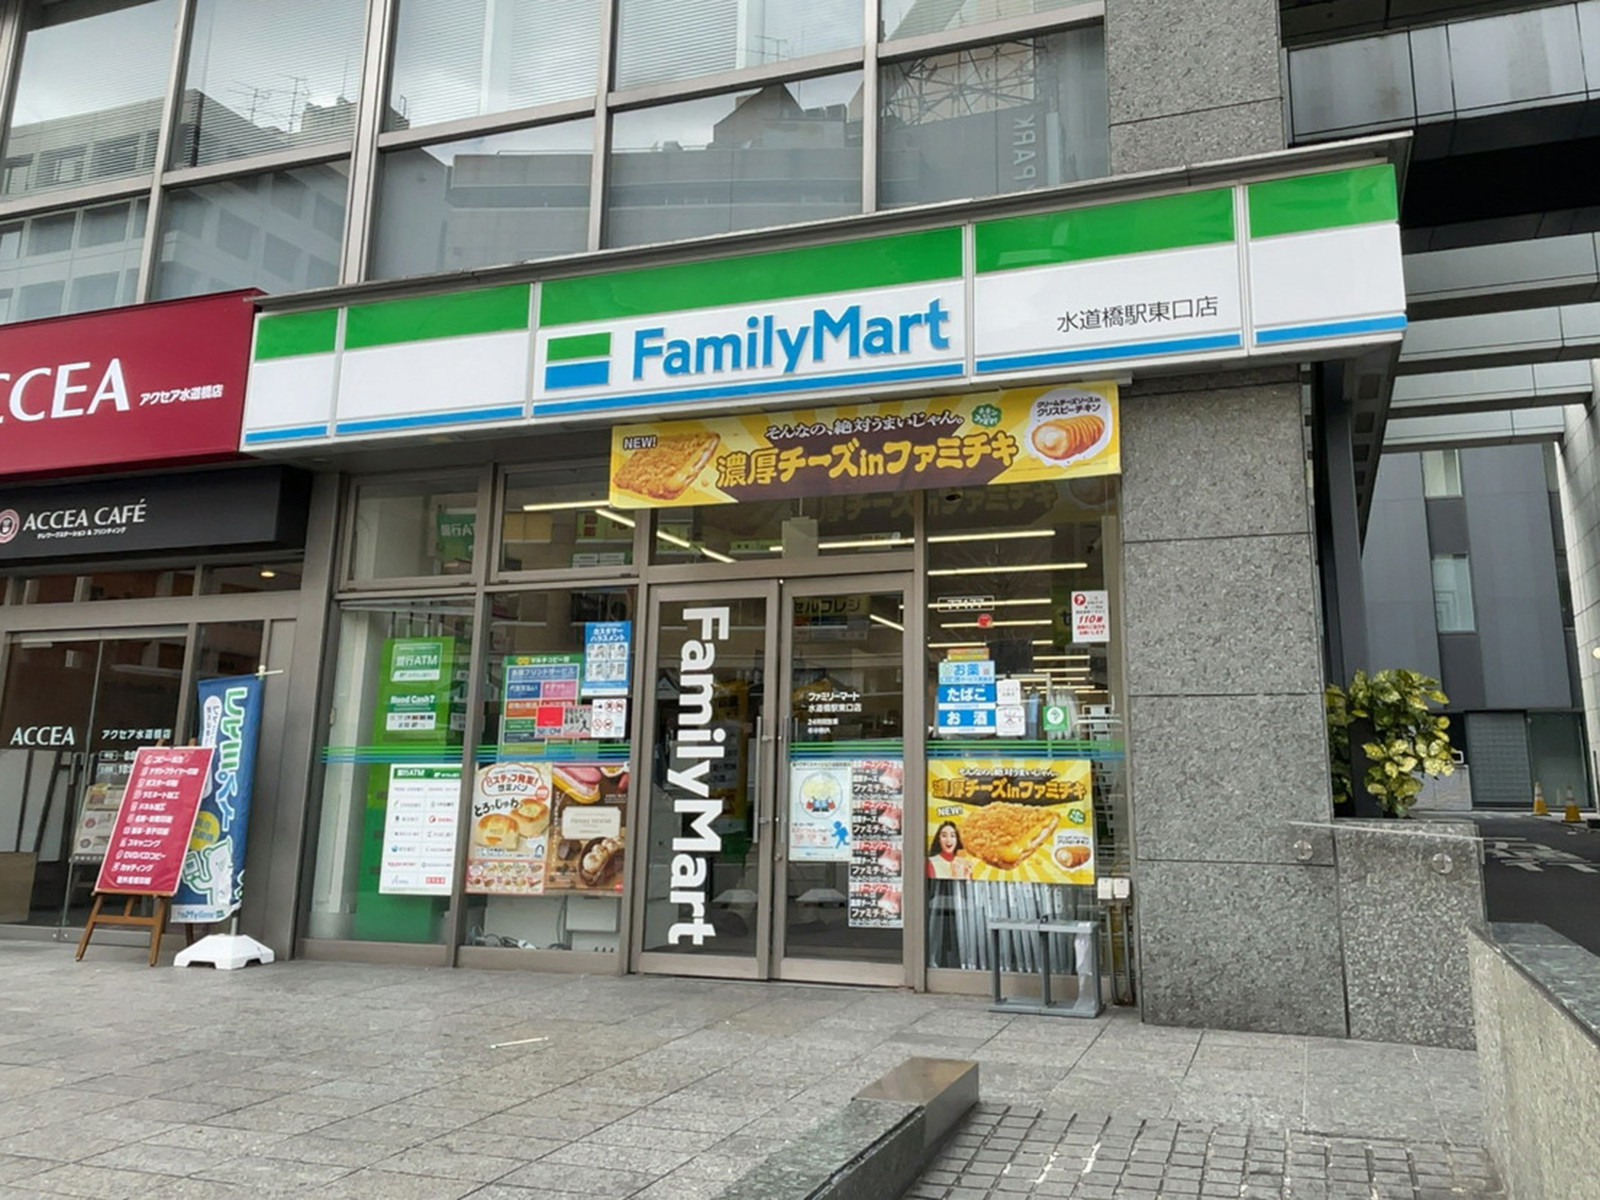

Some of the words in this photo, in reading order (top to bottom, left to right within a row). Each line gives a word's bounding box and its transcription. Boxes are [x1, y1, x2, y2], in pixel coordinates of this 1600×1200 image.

[1057, 295, 1218, 333] 水道橋駅東口店
[633, 298, 950, 381] FamilyMart
[0, 358, 130, 424] CEA
[139, 384, 224, 406] アクセア水道橋店
[1037, 404, 1101, 417] クリスピーチキン
[766, 410, 964, 440] そんなの、絶対うまいじゃん。
[623, 436, 657, 450] NEW!
[716, 430, 1019, 488] 濃厚チーズinファミチキ
[23, 508, 89, 531] ACCEA
[94, 498, 147, 525] CAFÉ
[391, 695, 410, 704] Need
[411, 695, 435, 704] Cash?
[808, 692, 860, 702] ファミリーマート
[947, 684, 987, 702] たばこ
[10, 726, 75, 746] ACCEA
[667, 606, 730, 945] FamilyMart
[932, 776, 1088, 799] 濃厚チーズinファミチキ
[938, 806, 963, 817] NEW!
